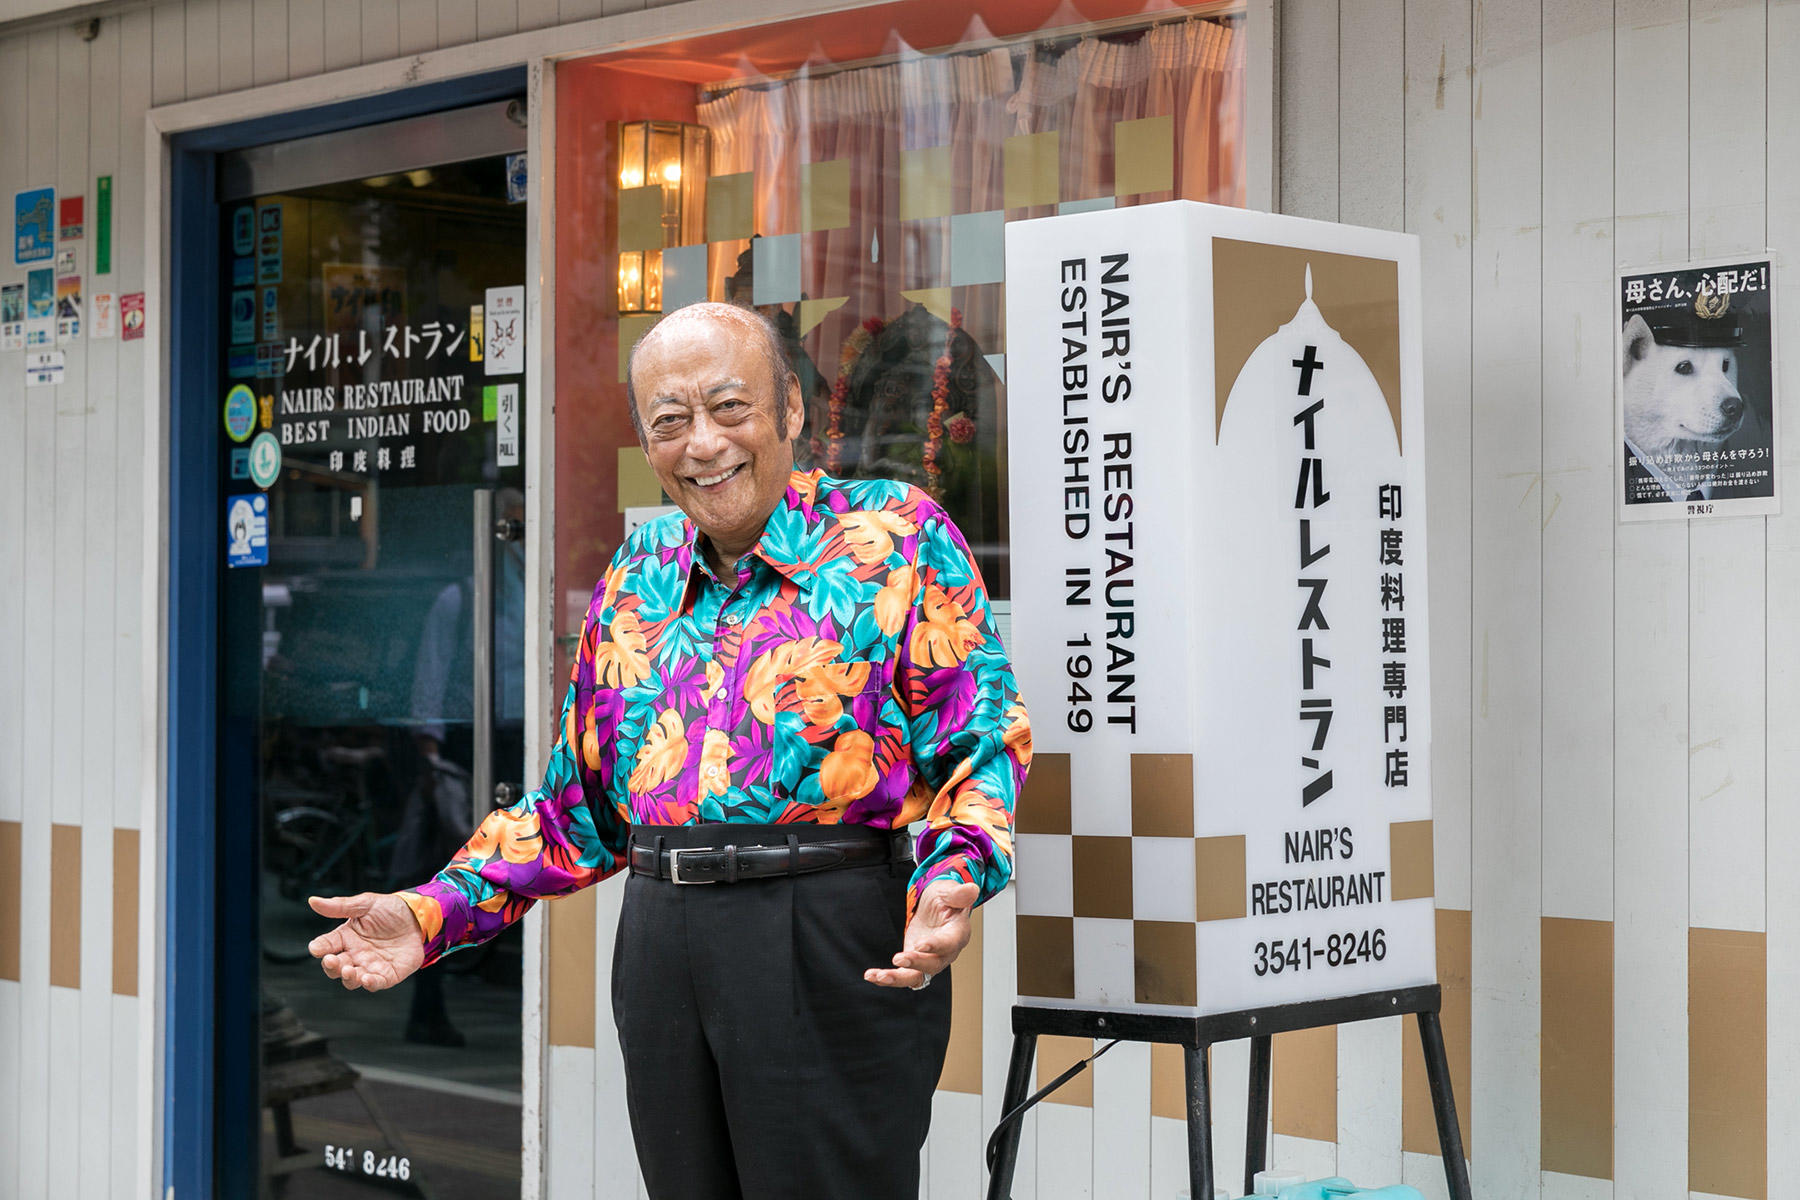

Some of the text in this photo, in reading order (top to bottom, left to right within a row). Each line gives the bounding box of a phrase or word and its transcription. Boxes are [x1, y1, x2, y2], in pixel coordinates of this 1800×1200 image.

[281, 374, 465, 415] NAIRS RESTAURANT
[502, 394, 514, 434] 引く
[281, 409, 471, 445] BEST INDIAN FOOD
[329, 445, 416, 473] 印度料理
[499, 443, 515, 457] PULL
[1061, 258, 1093, 733] ESTABLISHED IN 1949
[1101, 253, 1136, 734] NAIR'S RESTAURANT
[1687, 504, 1714, 515] 警視庁
[1292, 344, 1334, 809] ナイルレストラン
[1379, 483, 1409, 788] 印度料理専門店
[1285, 826, 1354, 864] NAIR'S
[1252, 871, 1386, 916] RESTAURANT
[1254, 928, 1387, 976] 3541-8246
[363, 1150, 411, 1181] 8246
